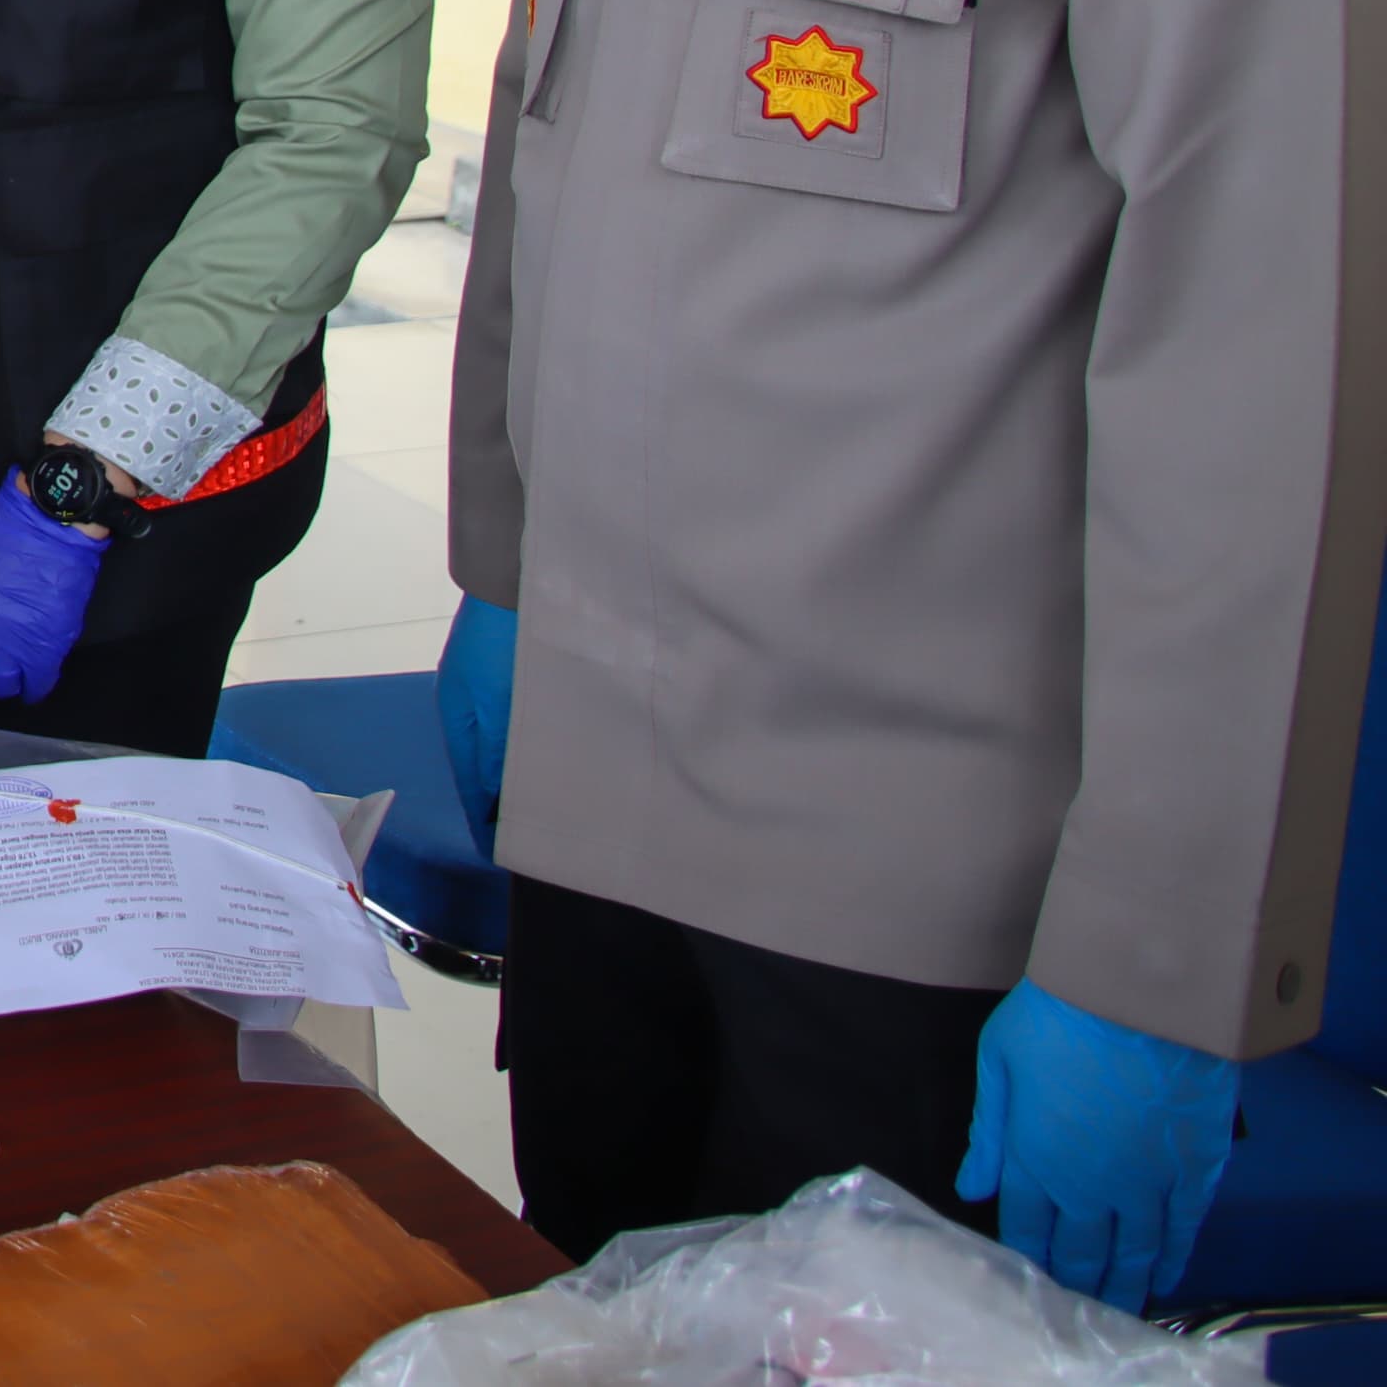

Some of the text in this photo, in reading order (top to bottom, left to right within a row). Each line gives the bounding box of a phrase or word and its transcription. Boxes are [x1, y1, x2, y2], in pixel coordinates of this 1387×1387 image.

[18, 924, 108, 946] LABEL BARANG BUKTI
